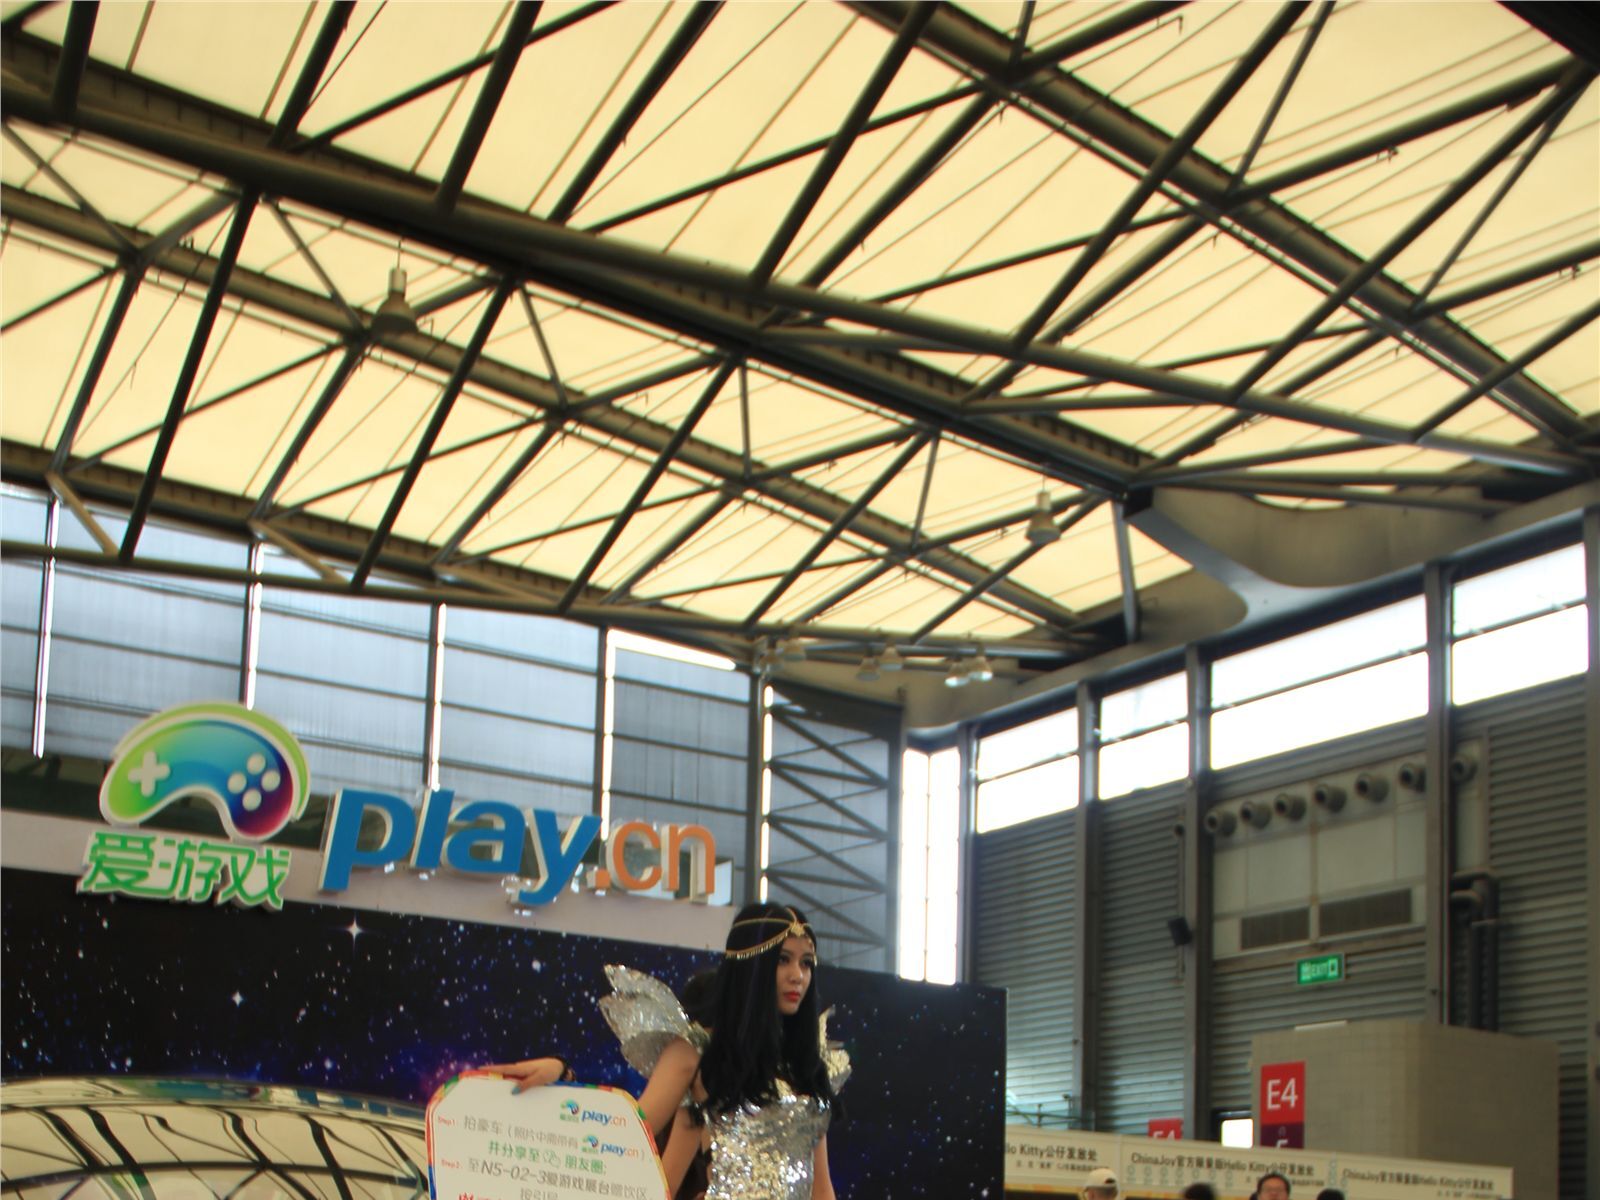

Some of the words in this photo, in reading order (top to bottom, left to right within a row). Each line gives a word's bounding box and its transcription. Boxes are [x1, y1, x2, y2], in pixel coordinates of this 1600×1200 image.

[81, 831, 291, 909] 爱游戏
[320, 788, 716, 907] play.cn
[580, 1110, 627, 1127] play.cn
[1267, 1077, 1299, 1110] E4
